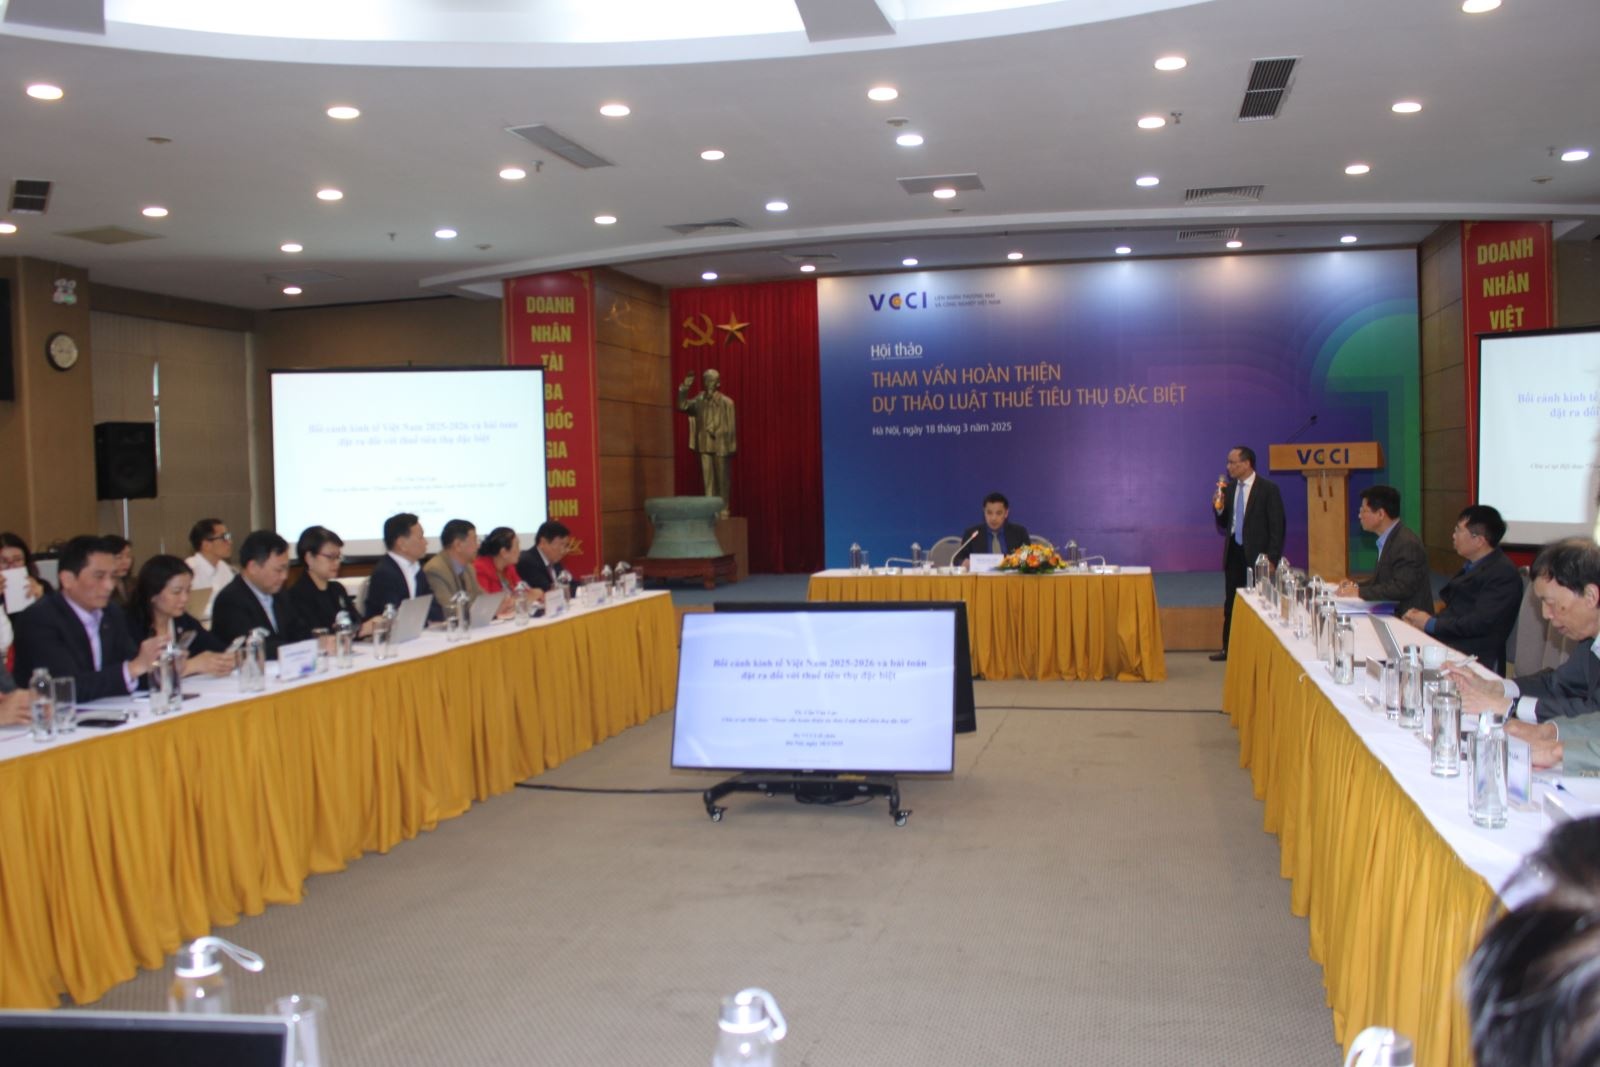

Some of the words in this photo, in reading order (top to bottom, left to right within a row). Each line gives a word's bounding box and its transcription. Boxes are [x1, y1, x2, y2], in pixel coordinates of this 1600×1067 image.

[1477, 238, 1534, 265] DOANH
[1483, 270, 1530, 298] NHÂN
[526, 296, 575, 314] DOANH
[869, 292, 927, 311] VCCI
[1489, 304, 1525, 332] VIỆT
[531, 321, 571, 343] NHÂN
[871, 344, 891, 358] Hội
[895, 341, 923, 357] thảo
[541, 351, 563, 372] TÀI
[872, 370, 918, 388] THAM
[922, 363, 957, 386] VẤN
[962, 362, 1010, 385] HOÀN
[1014, 361, 1061, 385] THIỆN
[544, 383, 563, 401] BA
[872, 396, 897, 416] DỰ
[902, 390, 945, 412] THẢO
[950, 389, 988, 413] LUẬT
[993, 385, 1035, 408] THUẾ
[1038, 386, 1071, 407] TIÊU
[1076, 387, 1109, 408] THỤ
[1114, 384, 1149, 407] ĐẶC
[1153, 382, 1187, 407] BIỆT
[545, 406, 574, 430] UỐC
[872, 426, 884, 436] Hà
[902, 425, 923, 438] ngày
[926, 424, 936, 434] 18
[937, 423, 961, 437] tháng
[963, 423, 969, 433] 3
[970, 422, 989, 433] năm
[991, 422, 1012, 432] 2025
[1296, 448, 1349, 465] VCCI
[547, 468, 577, 489] ƯNG
[830, 657, 875, 668] 2025-2026
